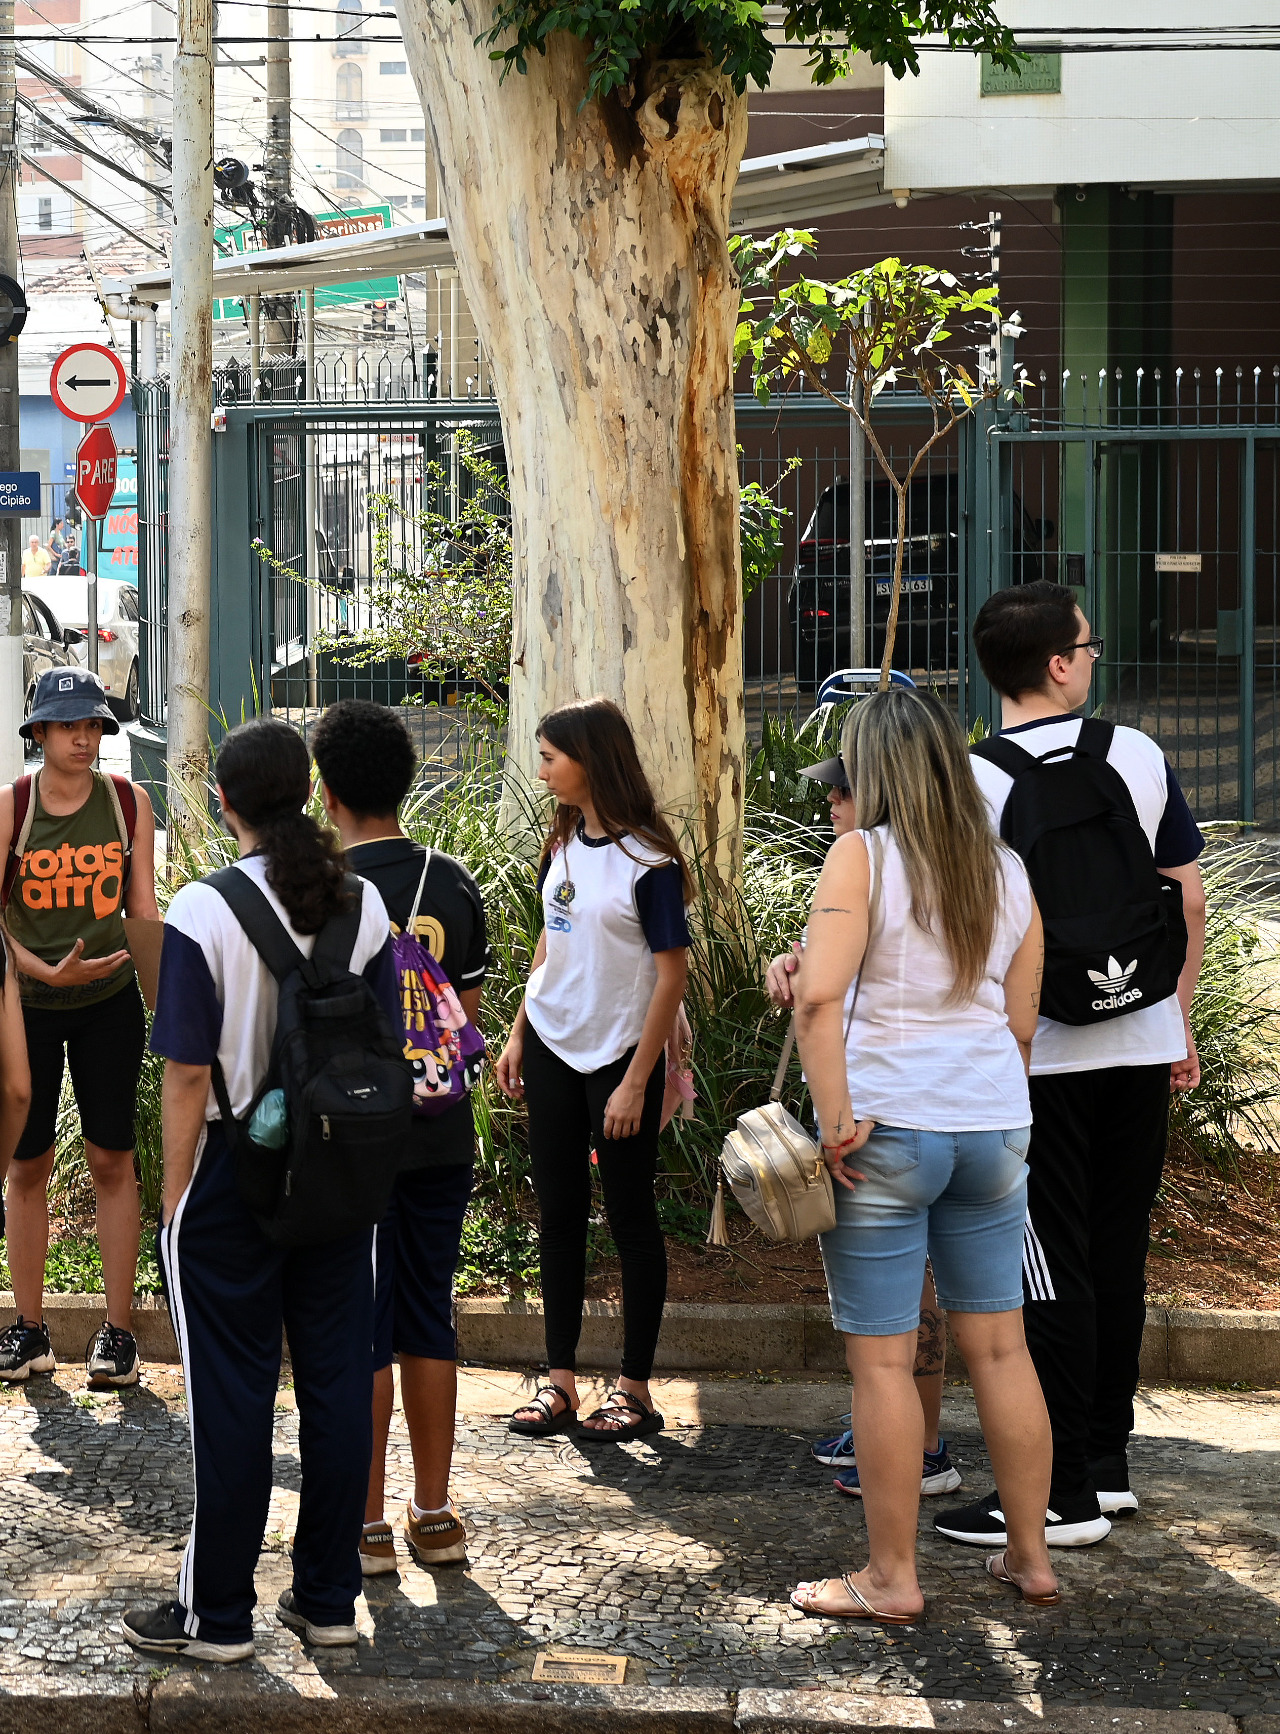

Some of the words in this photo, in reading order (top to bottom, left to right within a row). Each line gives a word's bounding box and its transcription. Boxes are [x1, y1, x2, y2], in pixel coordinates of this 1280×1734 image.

[80, 457, 115, 486] PARE
[0, 495, 31, 507] Cipião
[19, 842, 122, 878] rotas
[22, 866, 122, 920] afro
[1092, 988, 1142, 1010] adidas
